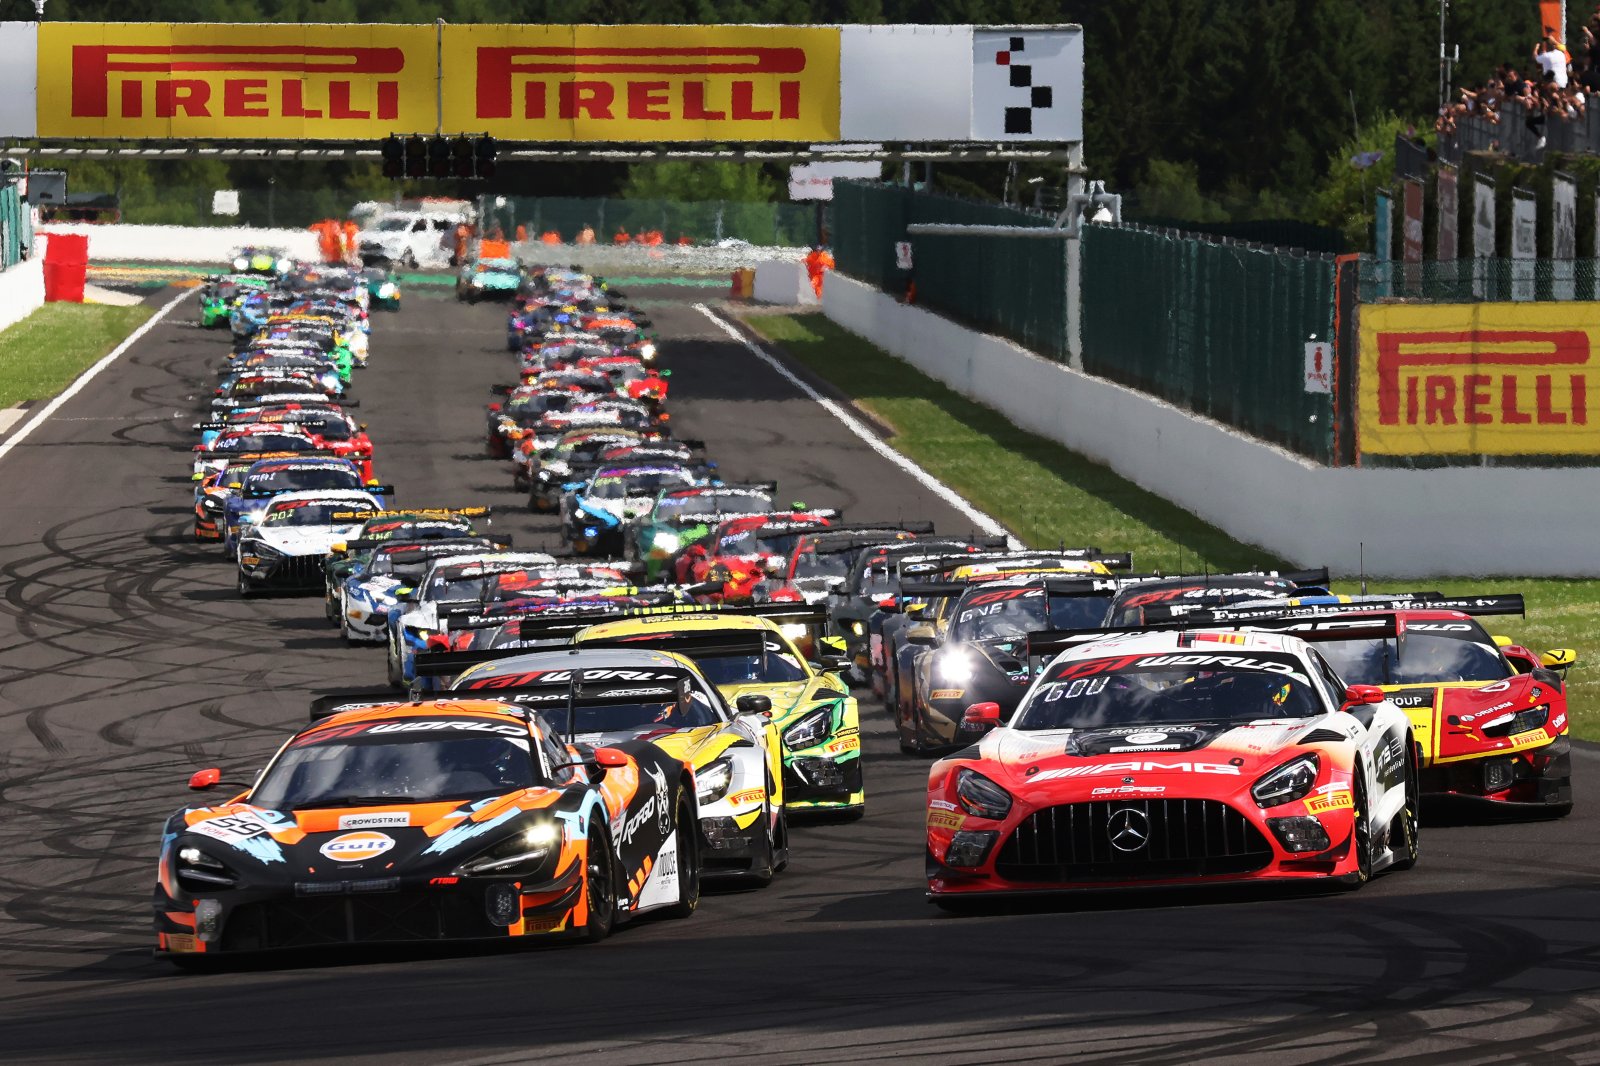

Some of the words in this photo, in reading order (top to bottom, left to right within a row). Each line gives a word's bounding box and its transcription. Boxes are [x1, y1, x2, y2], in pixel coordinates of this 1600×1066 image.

[71, 45, 404, 119] PIRELLI
[476, 46, 806, 120] PIRELLI
[1377, 331, 1590, 425] PIRELLI
[1056, 653, 1162, 680] GT
[1135, 655, 1294, 674] WORLD
[1044, 676, 1110, 702] GOU
[367, 721, 528, 736] WORLD
[829, 738, 858, 752] PIRELLI
[1514, 731, 1546, 745] PIRELLI
[1098, 761, 1251, 776] AMG
[1309, 794, 1350, 811] PIRELLI
[206, 817, 266, 836] 59
[346, 817, 407, 826] CROWDSTRIKE
[928, 812, 960, 827] PIRELLI
[327, 841, 387, 851] Gulf
